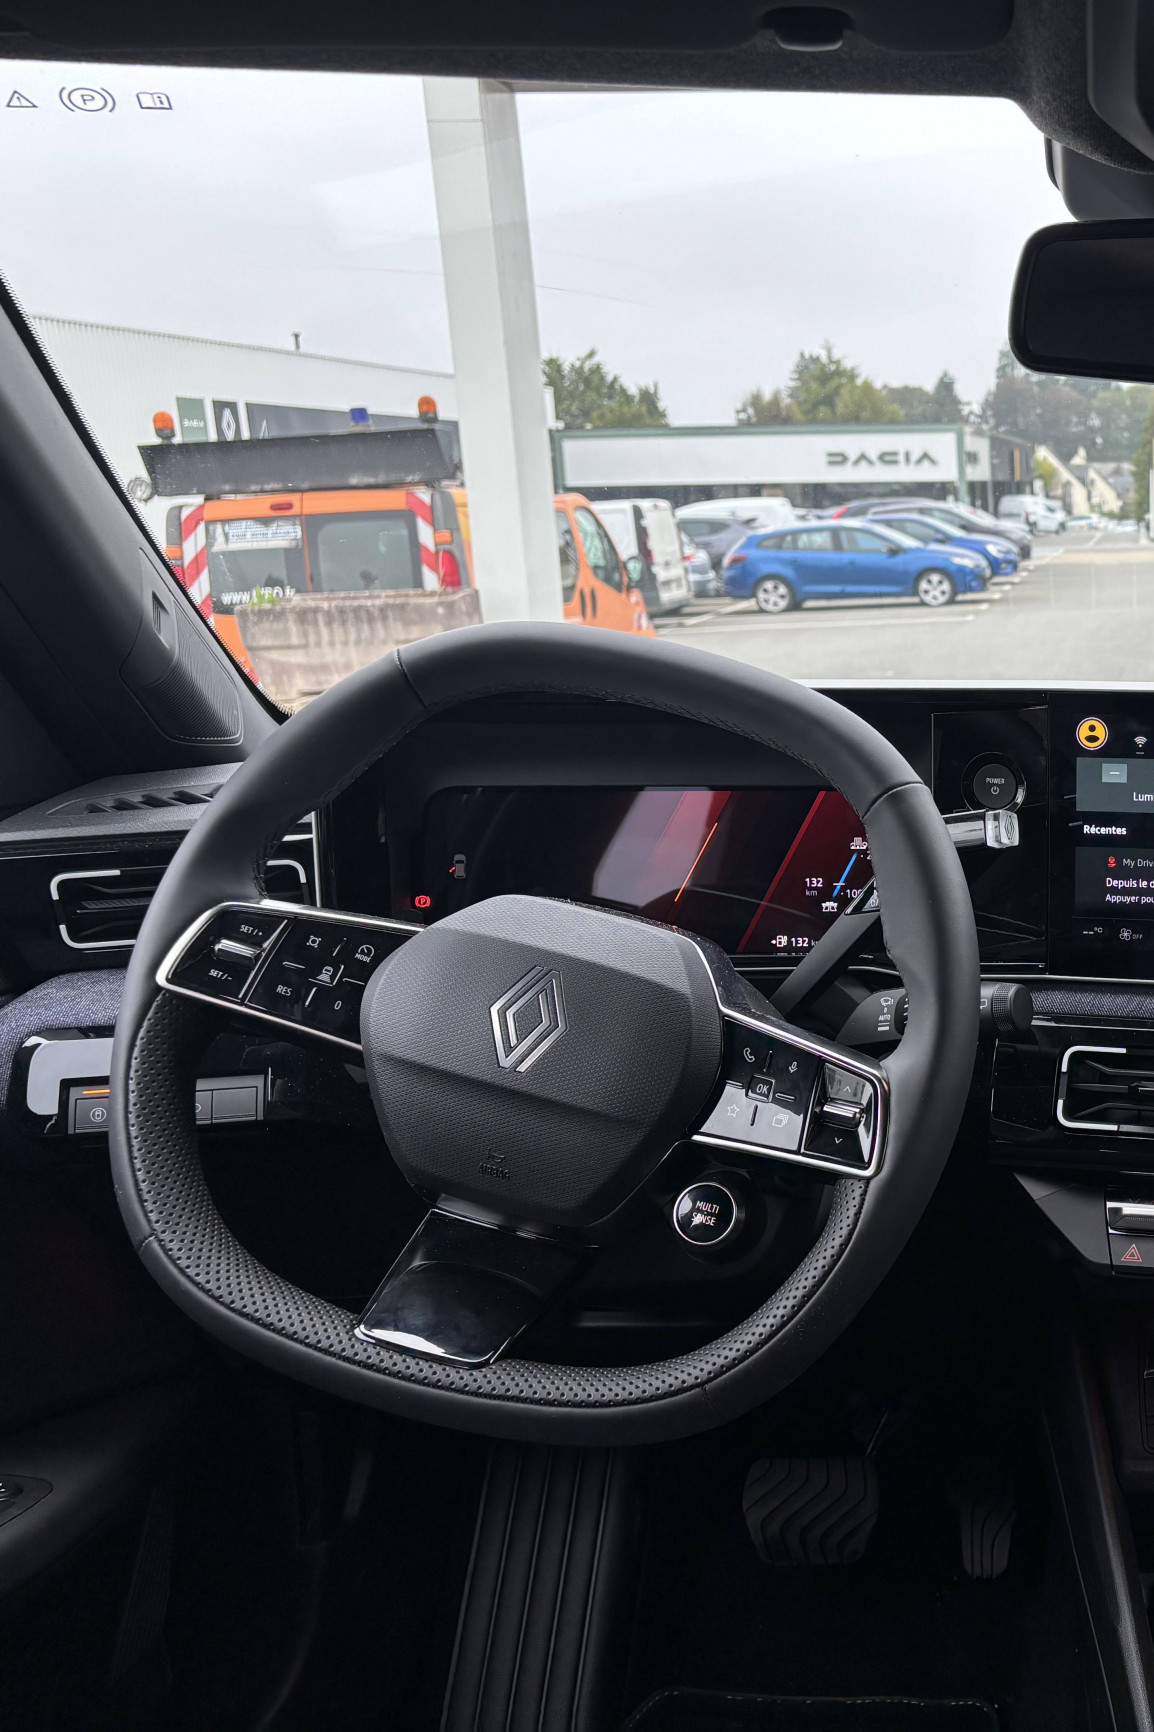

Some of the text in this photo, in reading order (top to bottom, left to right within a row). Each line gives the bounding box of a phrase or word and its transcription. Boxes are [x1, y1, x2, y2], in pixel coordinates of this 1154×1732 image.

[826, 450, 938, 467] DACIA
[1083, 824, 1127, 835] Récentes
[1122, 858, 1135, 869] My
[805, 878, 823, 887] 132
[1106, 878, 1137, 890] Depuis
[1139, 878, 1148, 888] le
[1105, 894, 1140, 904] Appuyer
[790, 937, 809, 947] 132
[354, 953, 372, 963] MODE
[276, 985, 293, 997] RES
[756, 1083, 769, 1095] OK
[695, 1200, 720, 1214] MULTI
[691, 1212, 717, 1227] SENSE
